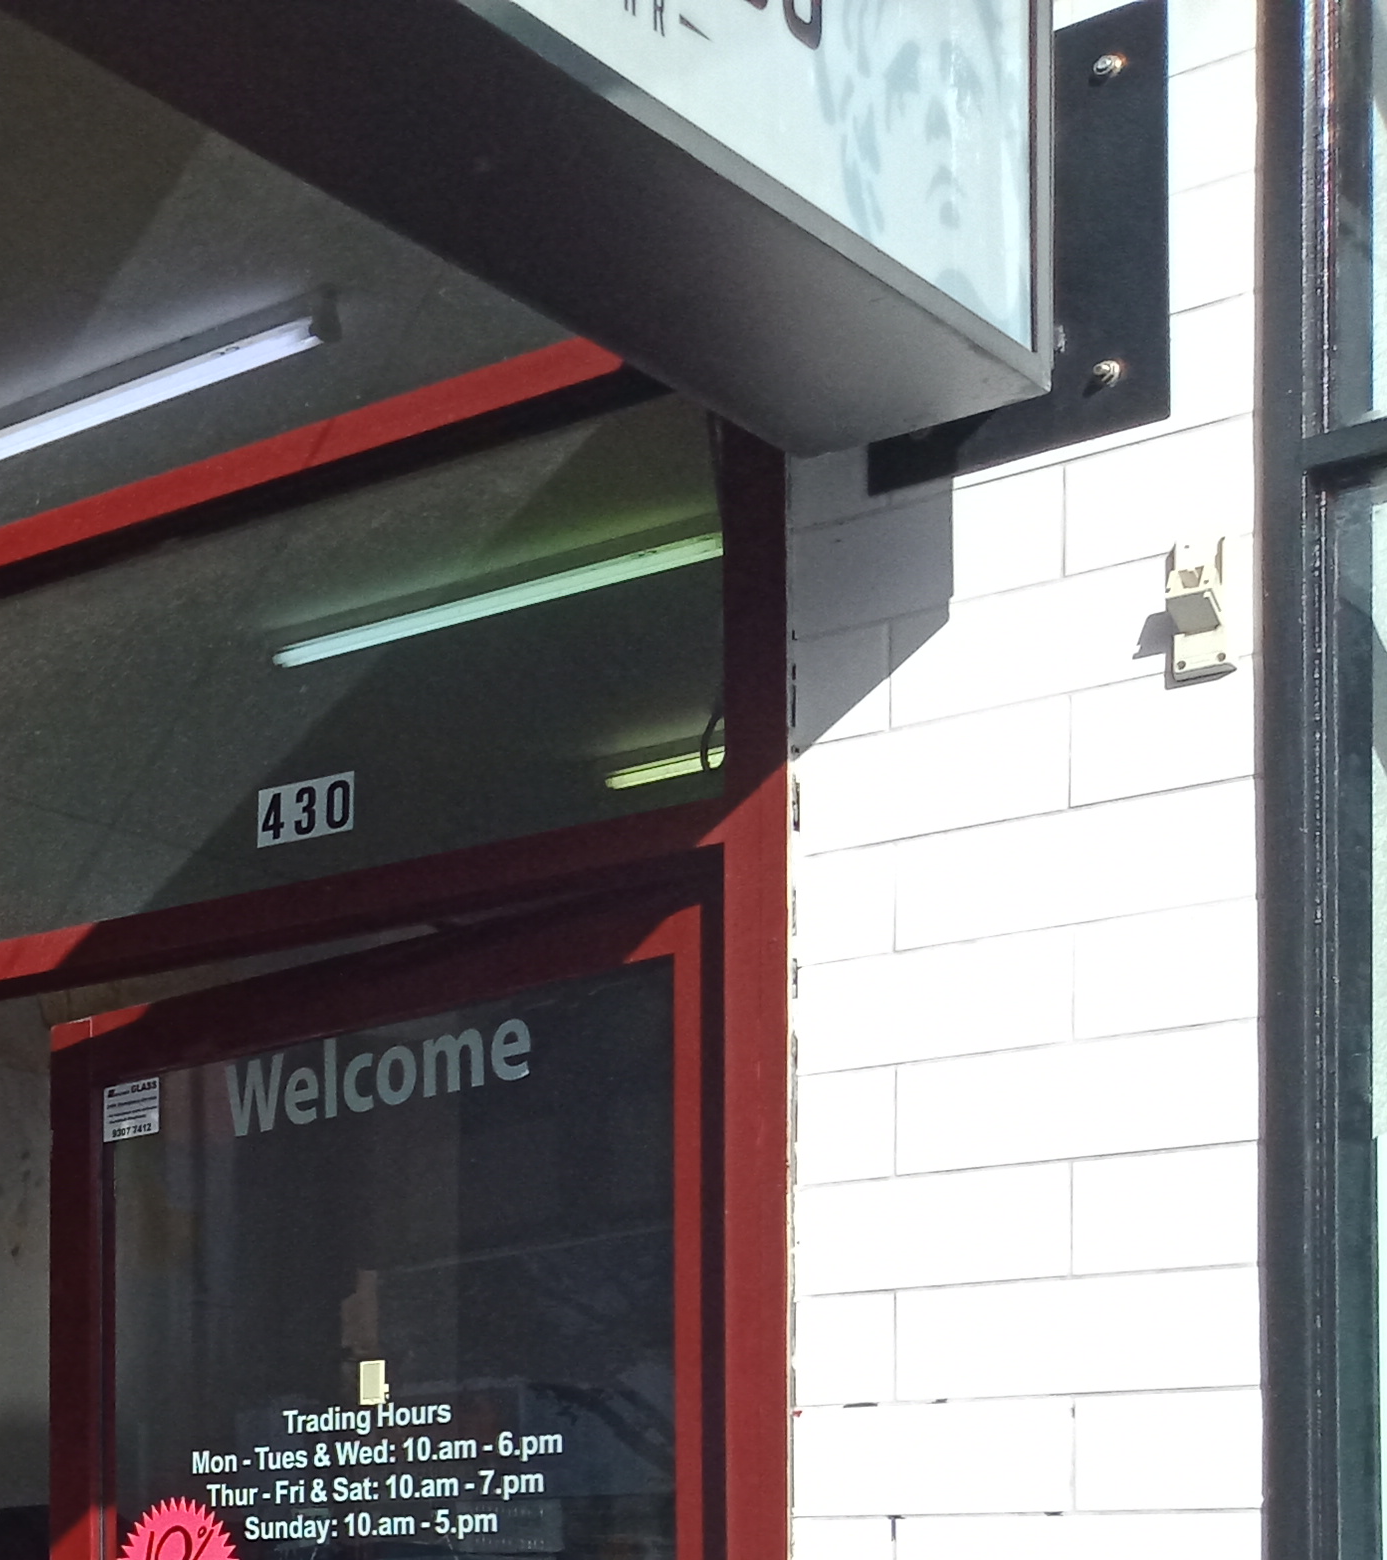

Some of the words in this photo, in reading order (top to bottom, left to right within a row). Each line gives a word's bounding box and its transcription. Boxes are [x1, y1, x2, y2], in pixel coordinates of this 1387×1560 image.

[261, 780, 351, 840] 430
[227, 1017, 532, 1136] Welcome
[282, 1407, 371, 1435] Trading
[377, 1402, 453, 1428] Hours
[192, 1449, 238, 1475] Mon
[255, 1446, 308, 1471] Tues
[313, 1443, 331, 1468] &
[336, 1439, 396, 1466] Wed:
[403, 1435, 477, 1461] 10.am
[498, 1431, 563, 1462] 6.pm
[206, 1483, 257, 1508] Thur
[275, 1479, 305, 1504] Fri
[310, 1477, 328, 1502] &
[332, 1476, 379, 1502] Sat:
[385, 1473, 459, 1499] 10.am
[479, 1470, 545, 1499] 7.pm
[245, 1513, 338, 1544] Sunday:
[344, 1512, 415, 1538] 10.am
[435, 1509, 498, 1540] 5.pm
